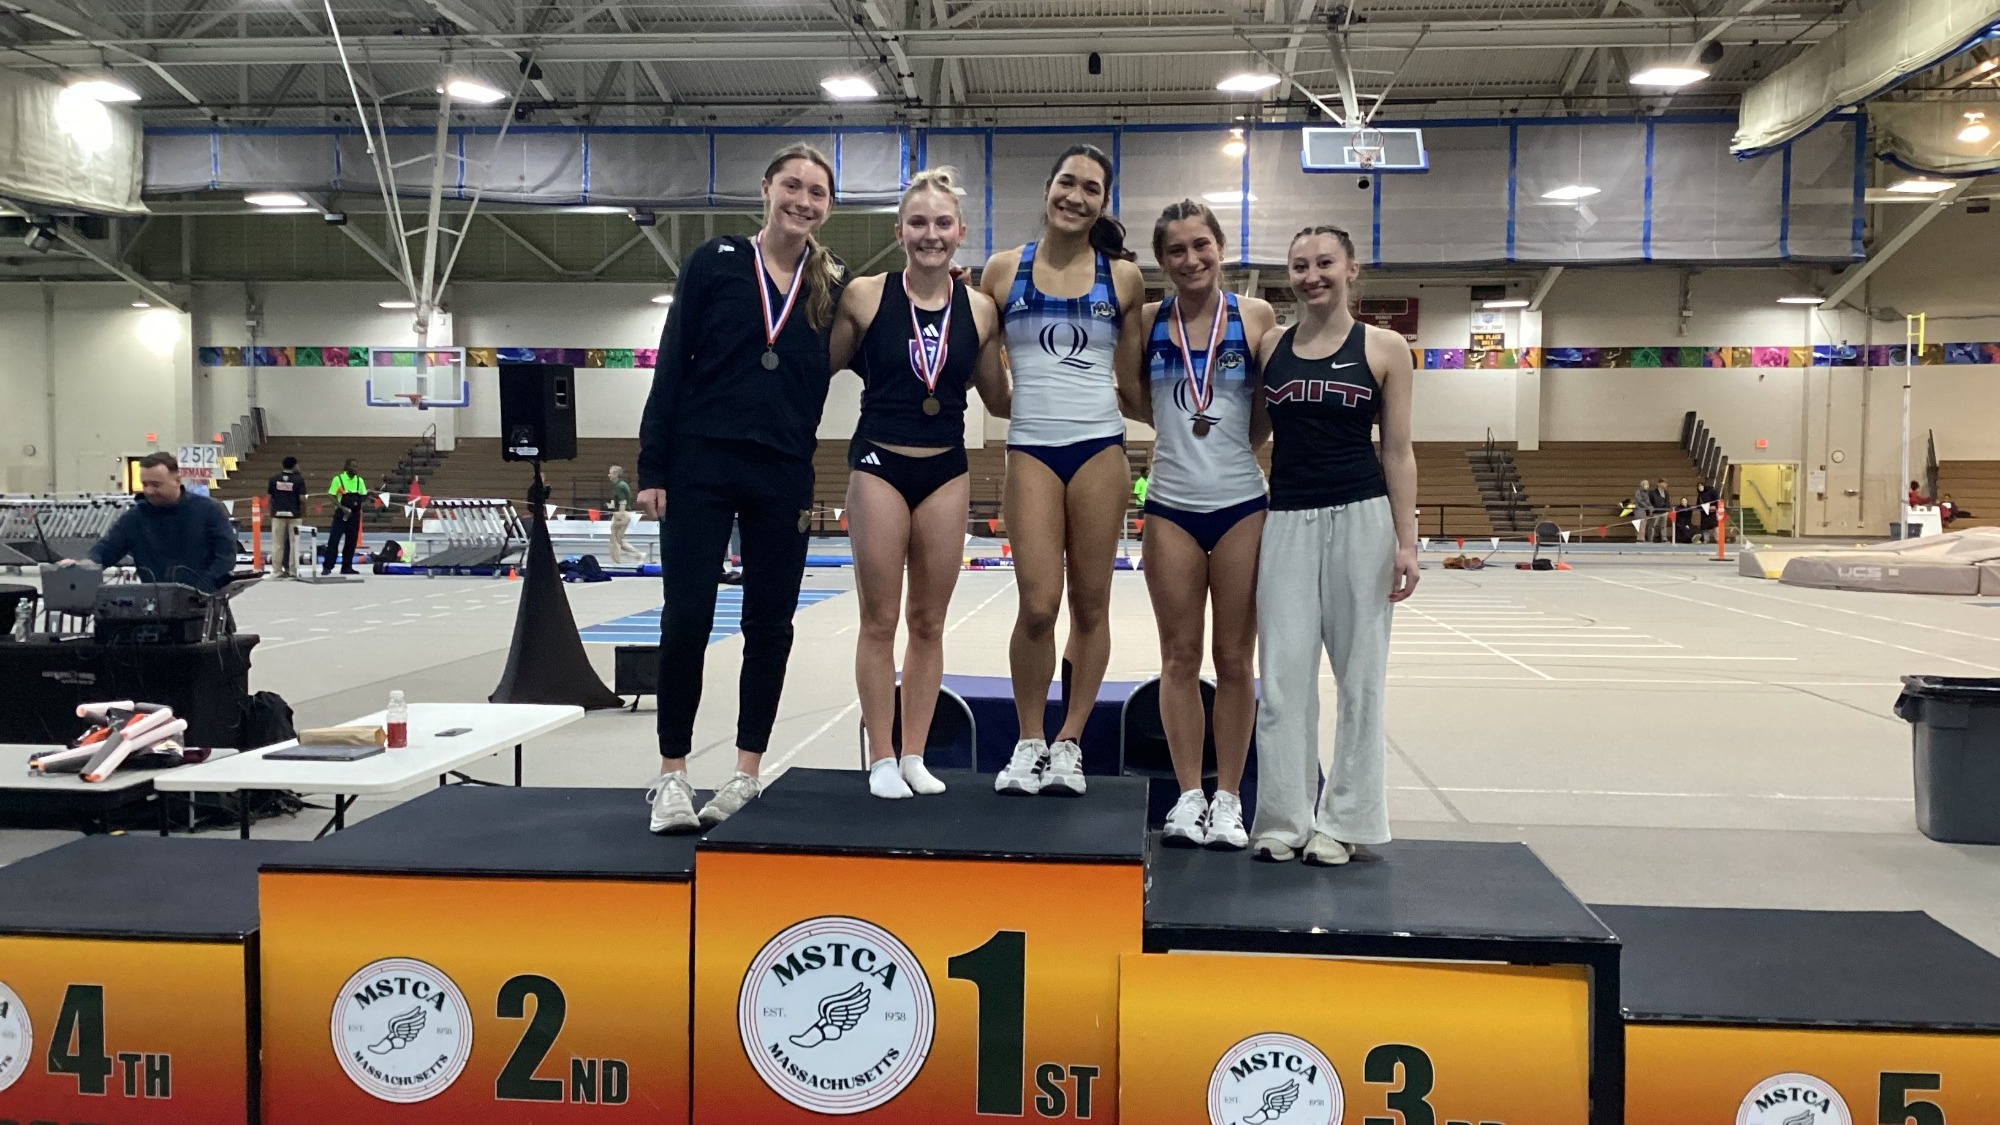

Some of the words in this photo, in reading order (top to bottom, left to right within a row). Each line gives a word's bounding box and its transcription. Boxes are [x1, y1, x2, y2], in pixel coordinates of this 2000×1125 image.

[1039, 322, 1096, 369] Q
[1263, 380, 1372, 408] MIT
[1838, 566, 1882, 578] UCS
[770, 943, 898, 991] MSTCA
[353, 977, 446, 1012] MSTCA
[763, 1007, 786, 1018] EST.
[885, 1011, 907, 1021] 1958
[947, 929, 1099, 1119] 1ST
[47, 983, 172, 1099] 4TH
[495, 973, 629, 1105] 2ND
[353, 1050, 448, 1086] MASSACHUSETTS
[768, 1042, 900, 1091] MASSACHUSETTS
[1229, 1051, 1318, 1085] MSTCA
[1755, 1087, 1831, 1114] MSTCA
